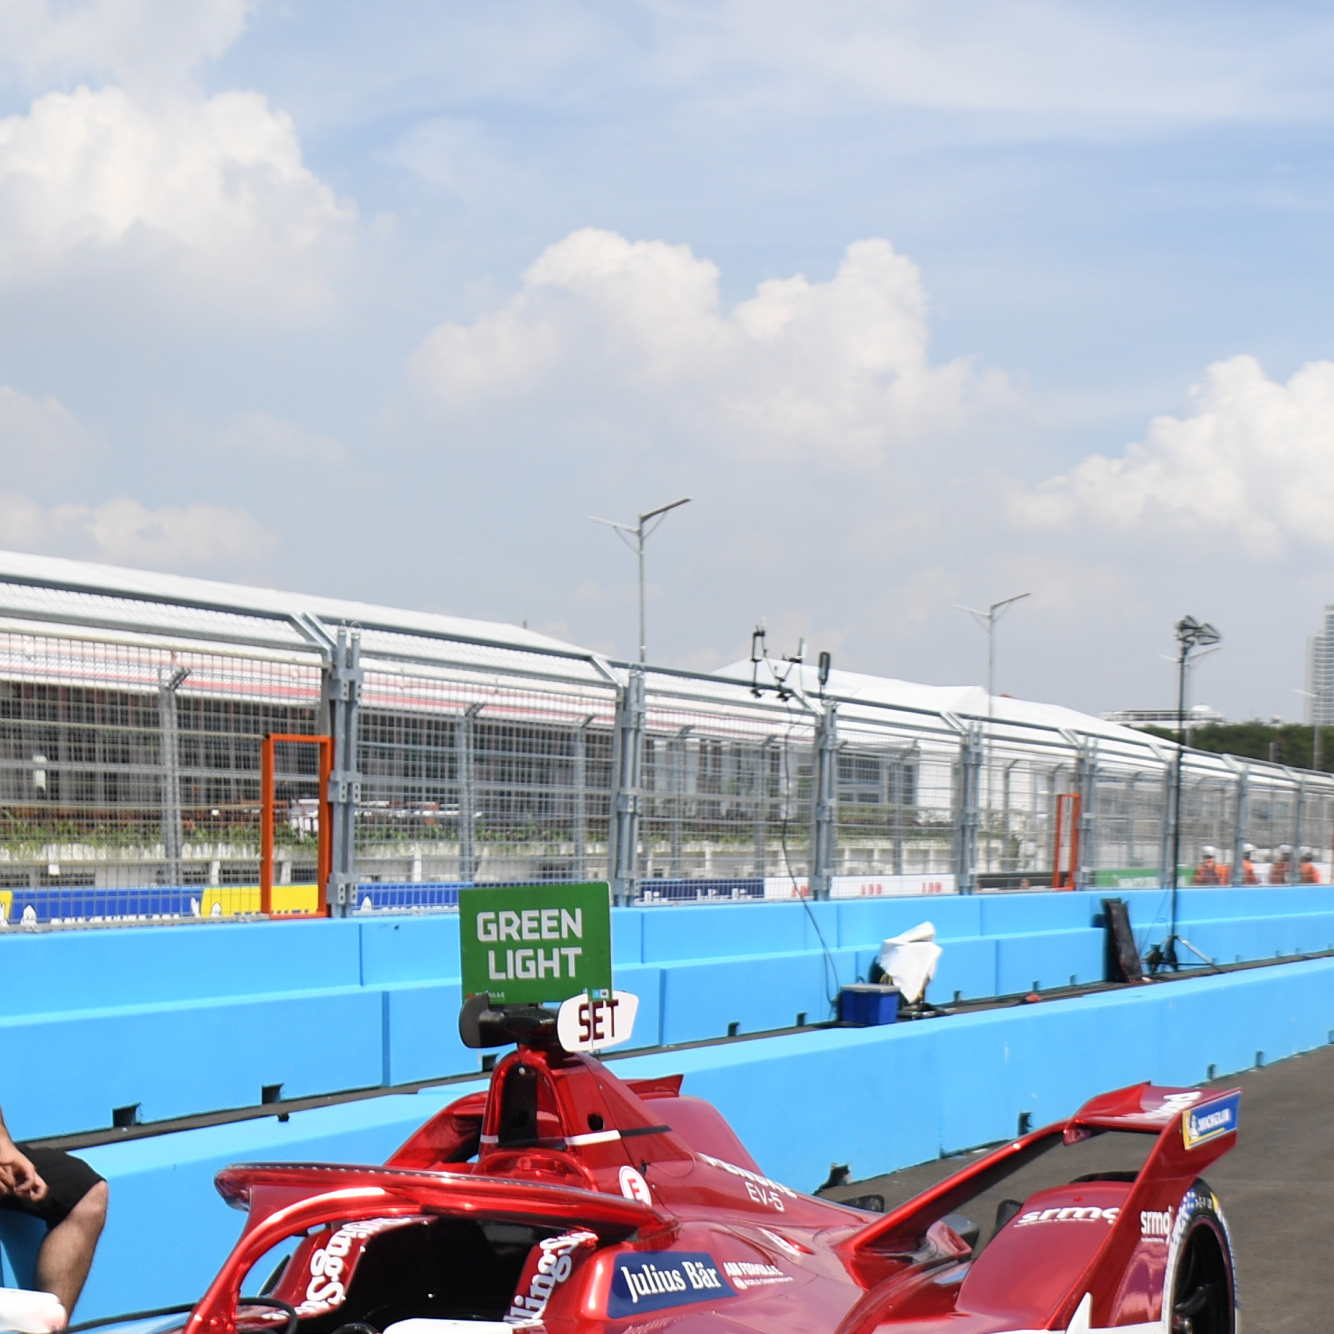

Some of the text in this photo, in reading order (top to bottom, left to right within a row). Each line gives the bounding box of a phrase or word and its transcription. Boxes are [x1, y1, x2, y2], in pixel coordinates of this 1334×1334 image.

[476, 908, 583, 942] GREEN
[488, 947, 583, 980] LIGHT
[578, 999, 619, 1043] SET
[744, 1181, 785, 1213] EV-5
[620, 1261, 721, 1304] Julius Bär
